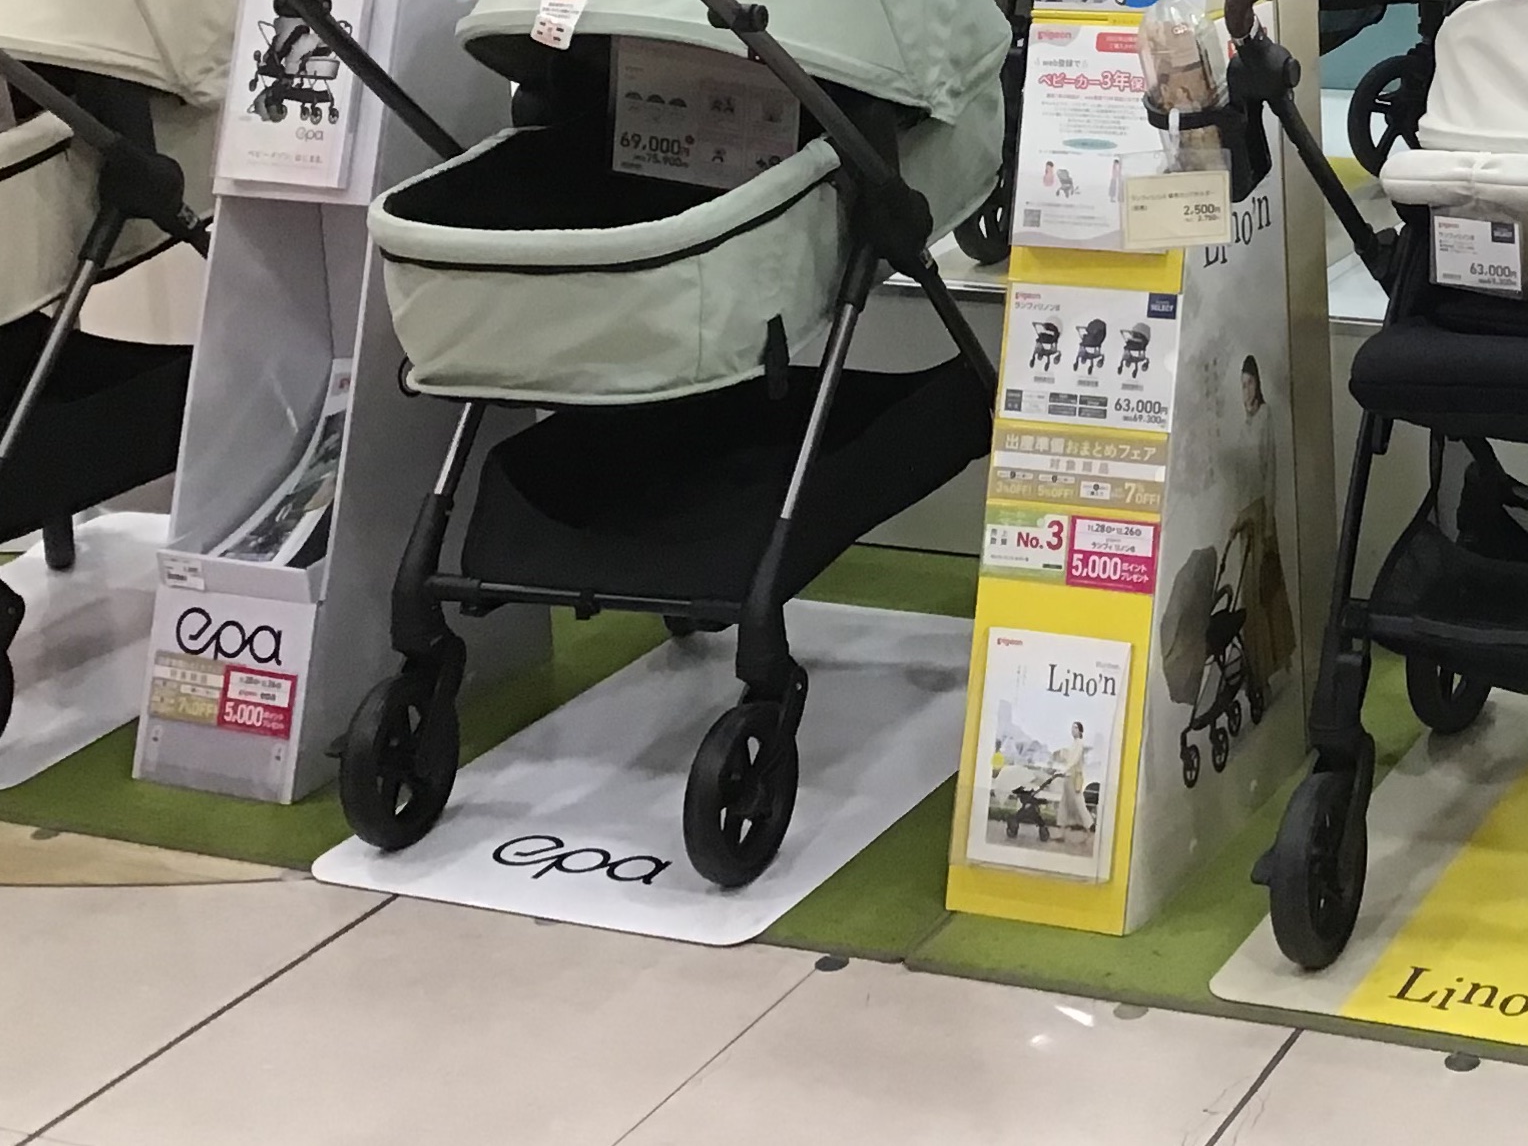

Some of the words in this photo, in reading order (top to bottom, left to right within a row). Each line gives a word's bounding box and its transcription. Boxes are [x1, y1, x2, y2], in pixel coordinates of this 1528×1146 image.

[1038, 70, 1147, 93] ベビーカー3年保
[1114, 397, 1168, 415] 63,000円
[1016, 519, 1064, 551] No.3
[1071, 553, 1121, 581] 5,000
[176, 607, 282, 666] epa
[1047, 663, 1117, 698] Lino'n
[492, 834, 673, 885] epa
